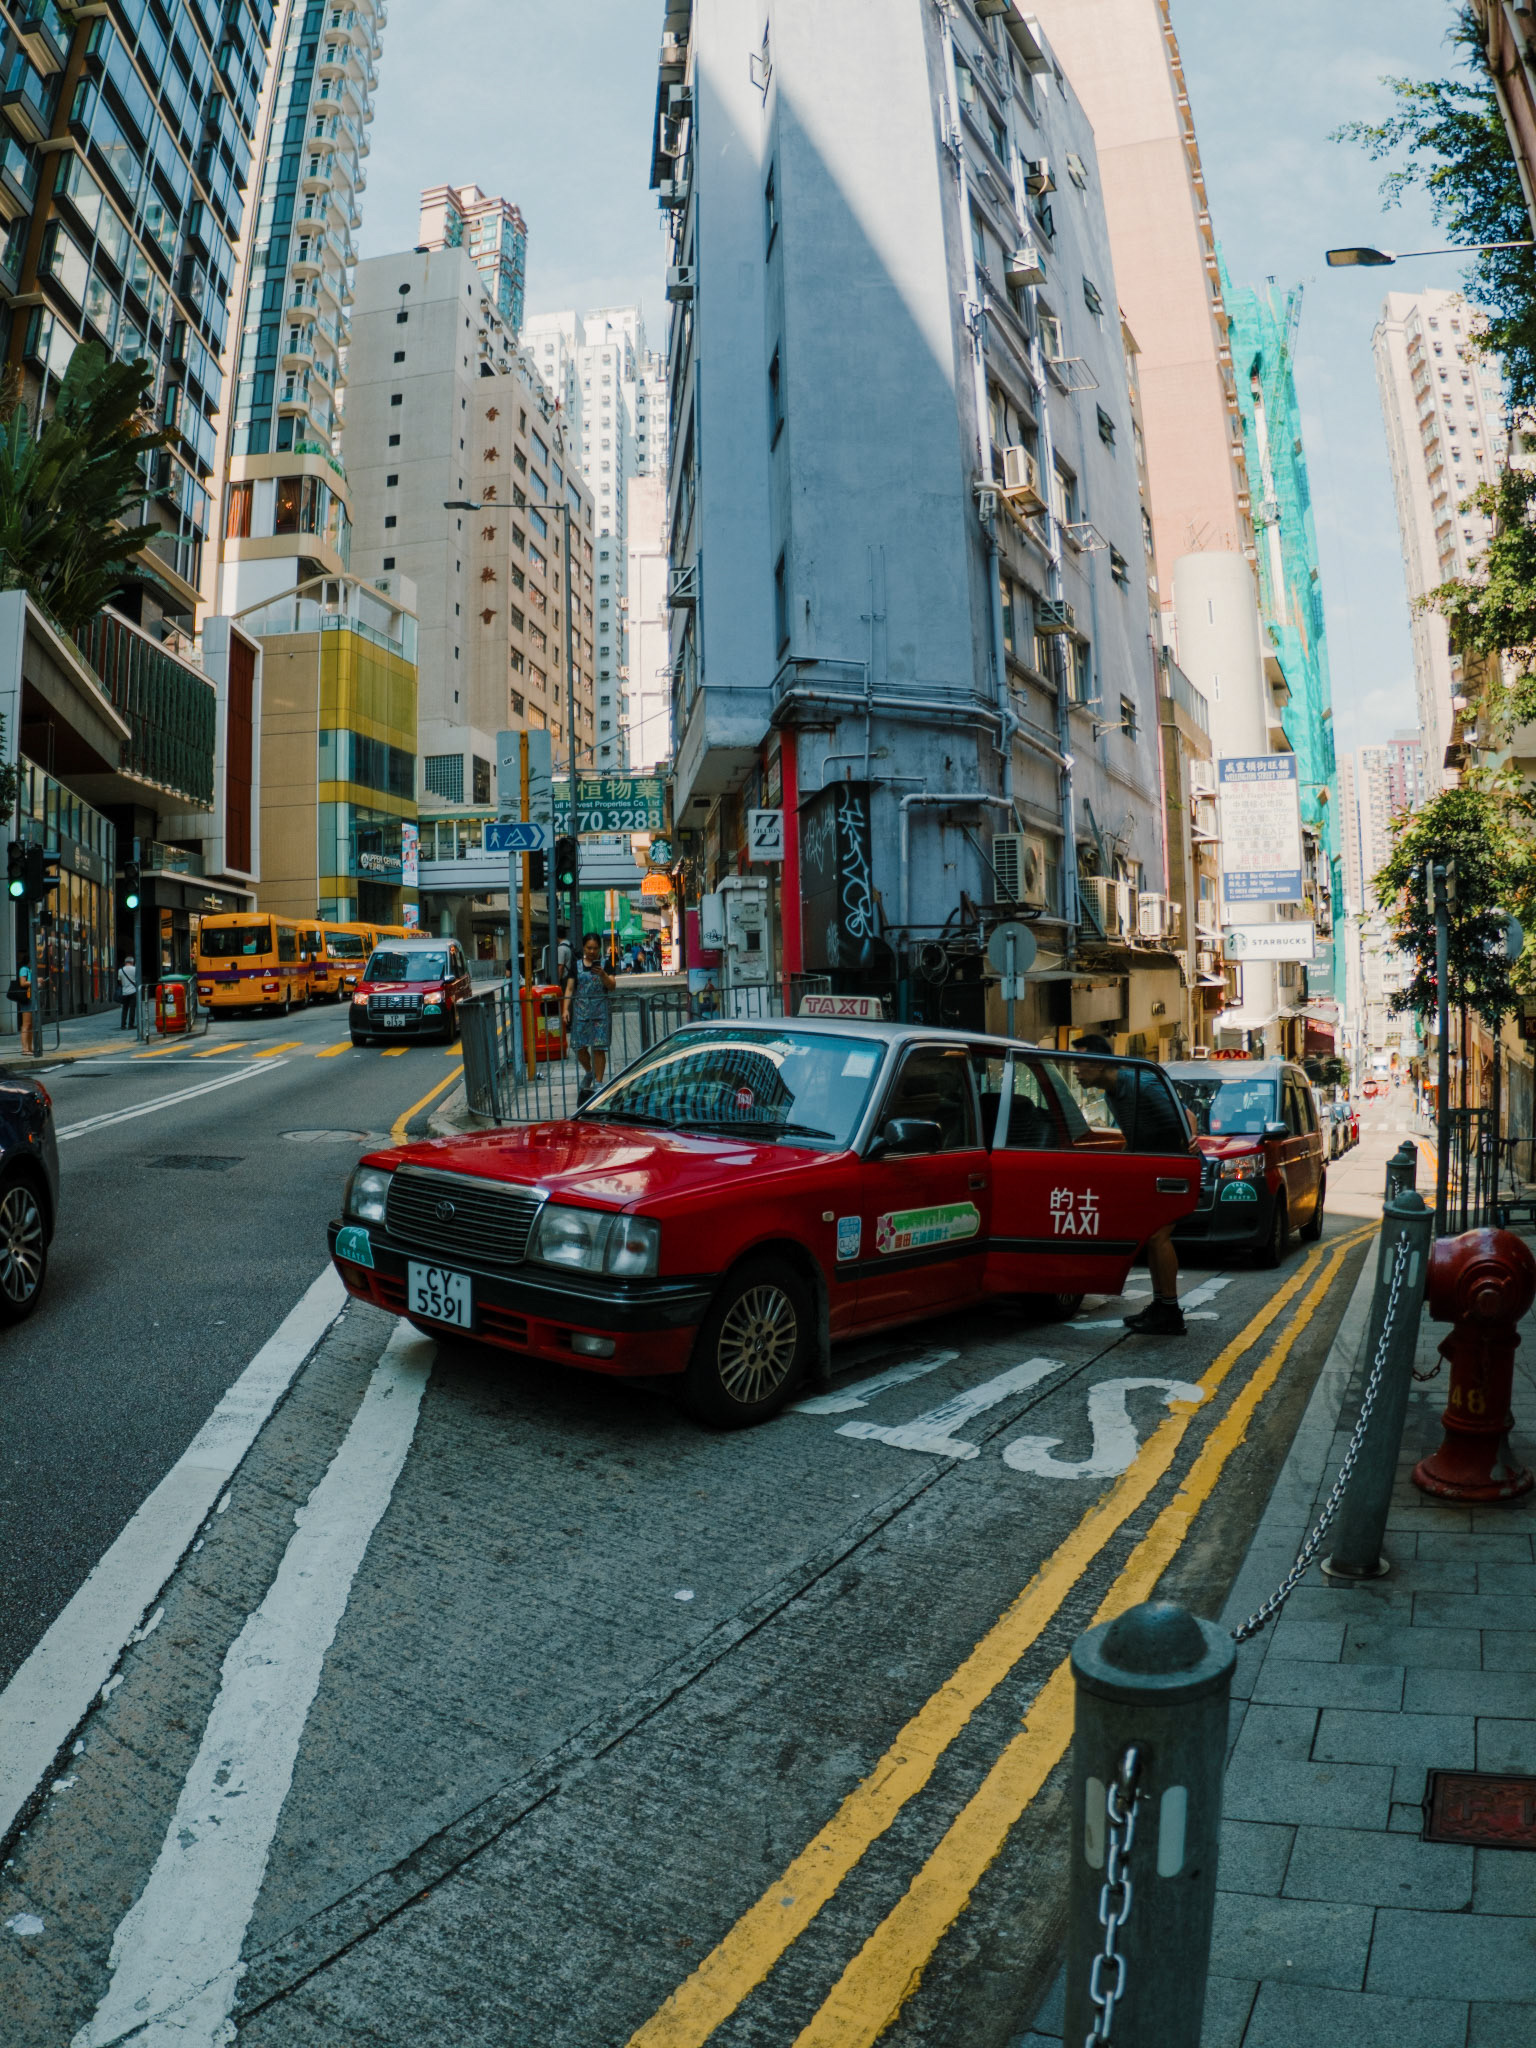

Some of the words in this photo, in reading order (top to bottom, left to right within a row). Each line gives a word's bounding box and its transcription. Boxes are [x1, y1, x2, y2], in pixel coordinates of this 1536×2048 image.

[1257, 771, 1275, 781] STREET
[565, 801, 593, 809] Hvest
[594, 800, 632, 809] Properties
[633, 799, 646, 807] Co.
[608, 810, 661, 831] 3288
[1252, 937, 1307, 946] STARBUCKS
[805, 997, 869, 1016] TAXI
[1213, 1049, 1247, 1059] TAXI
[1050, 1186, 1100, 1210] 的士
[1236, 1187, 1243, 1195] 4
[1049, 1211, 1100, 1236] TAXI
[349, 1236, 357, 1250] 4
[342, 1247, 366, 1263] SEATS
[426, 1268, 452, 1296] CY
[417, 1288, 462, 1323] 5591
